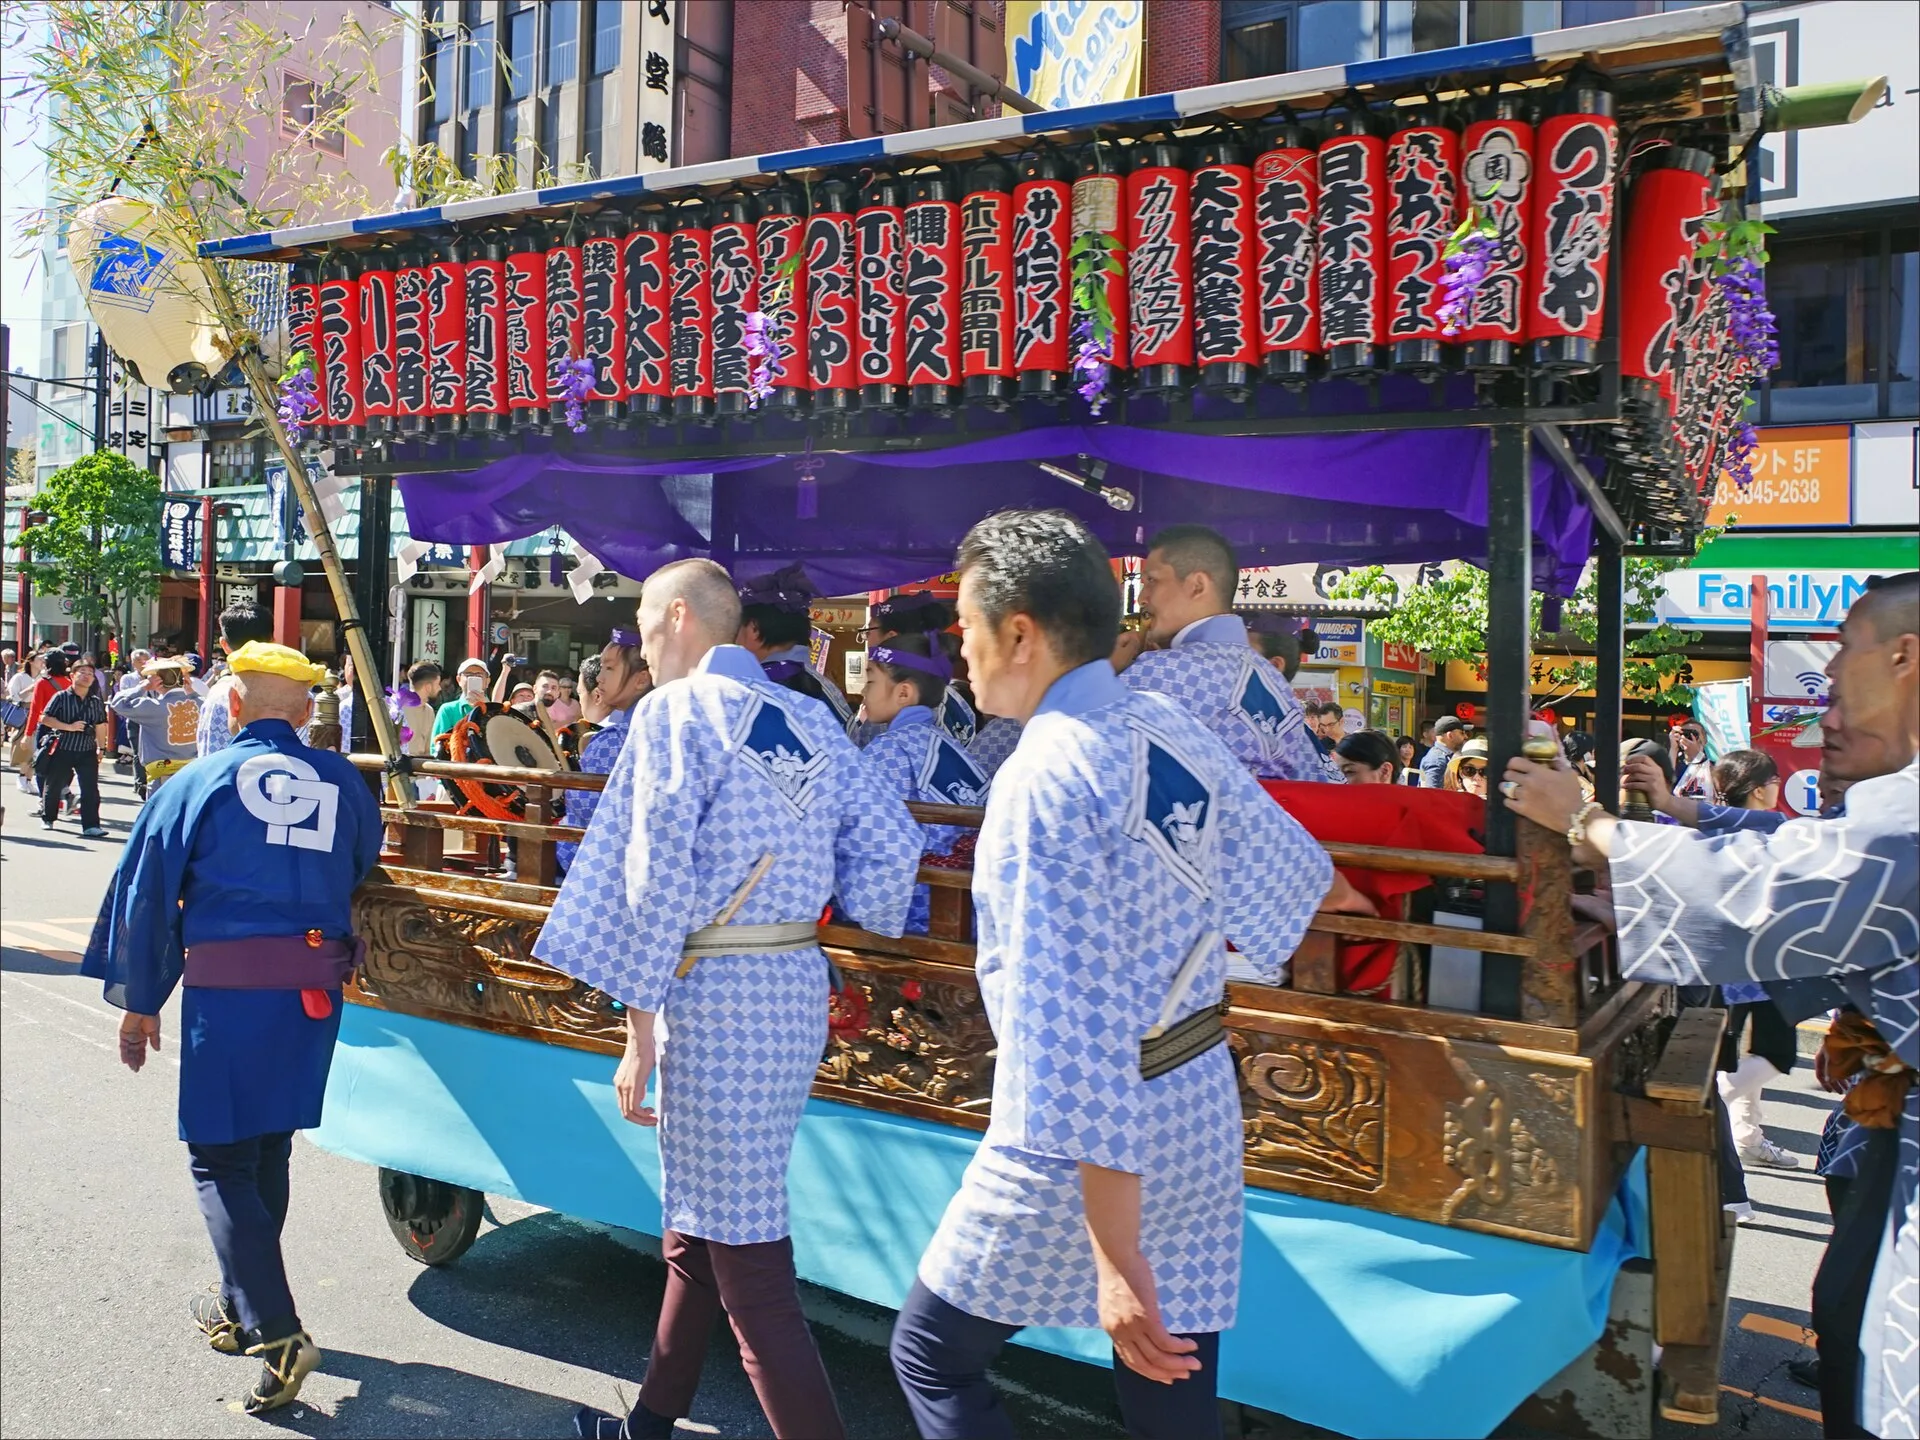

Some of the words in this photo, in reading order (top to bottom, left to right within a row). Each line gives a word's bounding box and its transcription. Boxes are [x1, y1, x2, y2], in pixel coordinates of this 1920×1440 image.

[856, 210, 901, 378] Tokyo
[961, 195, 1004, 372] ホテル雷門
[1026, 187, 1063, 344] サムライ
[1135, 175, 1185, 356] カリカチュア
[1318, 140, 1376, 346] 日本不動産
[127, 401, 147, 449] 三定
[1793, 448, 1821, 474] 5F
[425, 603, 440, 655] 人形焼
[1237, 574, 1288, 600] 華食堂
[1314, 622, 1358, 635] NUMBERS
